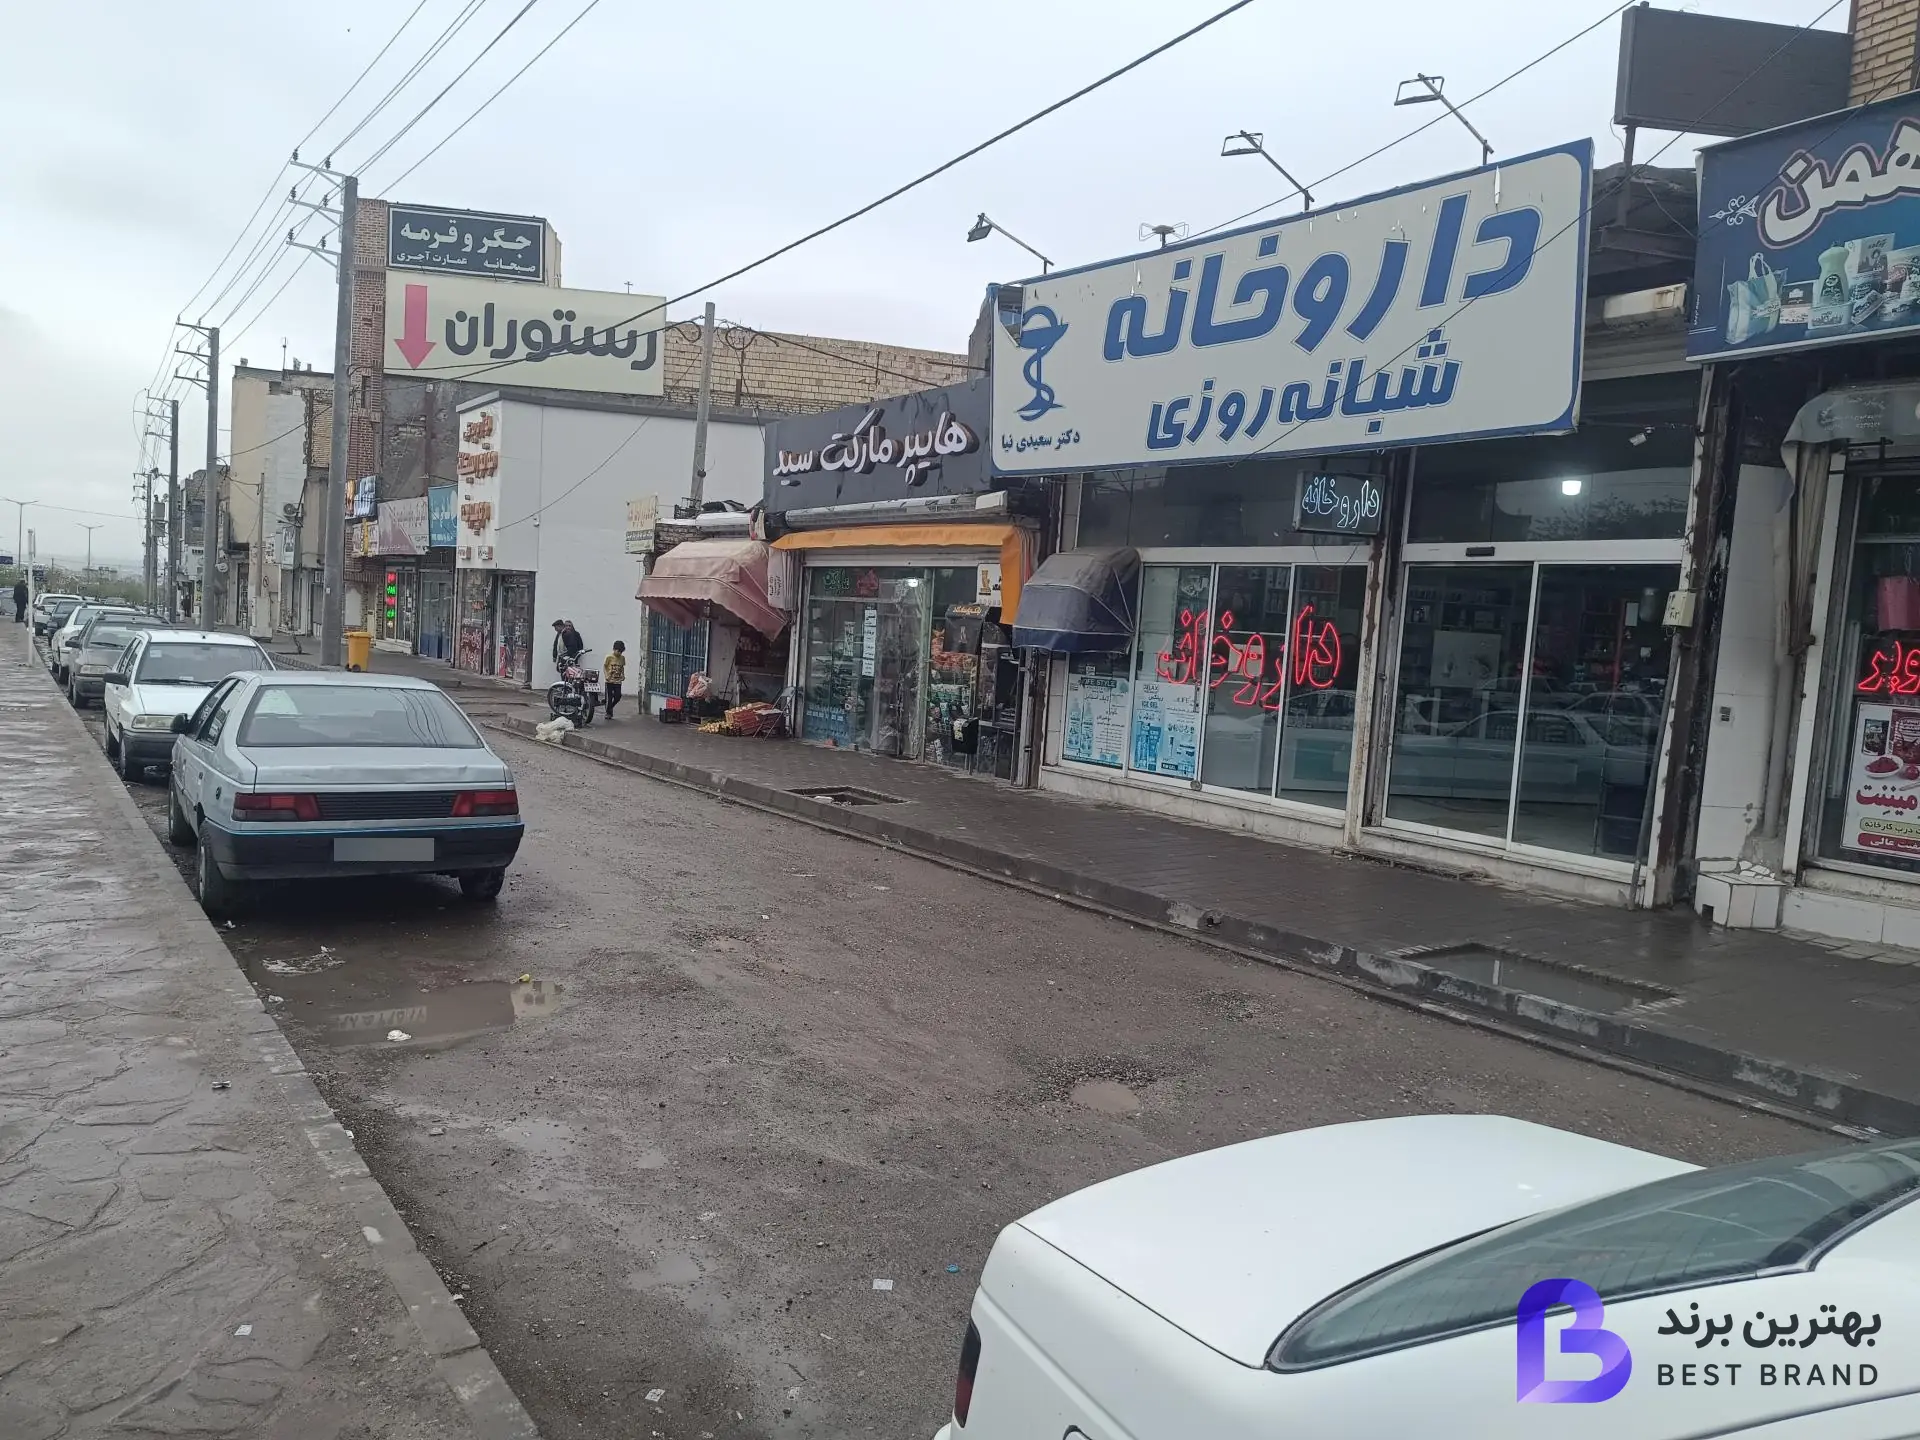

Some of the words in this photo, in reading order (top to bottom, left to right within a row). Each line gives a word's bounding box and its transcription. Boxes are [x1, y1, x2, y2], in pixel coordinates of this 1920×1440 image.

[400, 219, 458, 249] قرمه
[461, 232, 474, 252] و
[477, 228, 532, 259] جگر
[396, 251, 430, 263] آجری
[432, 253, 468, 265] عمارت
[483, 257, 536, 274] صبحانه
[445, 303, 658, 371] رستوران
[820, 408, 893, 473] مارکت
[896, 411, 968, 485] هایپر
[1001, 434, 1013, 453] نیا
[1016, 434, 1052, 453] سعیدی
[1054, 428, 1081, 451] دکتر
[1864, 821, 1893, 831] کارخانه
[1870, 837, 1895, 847] عالی
